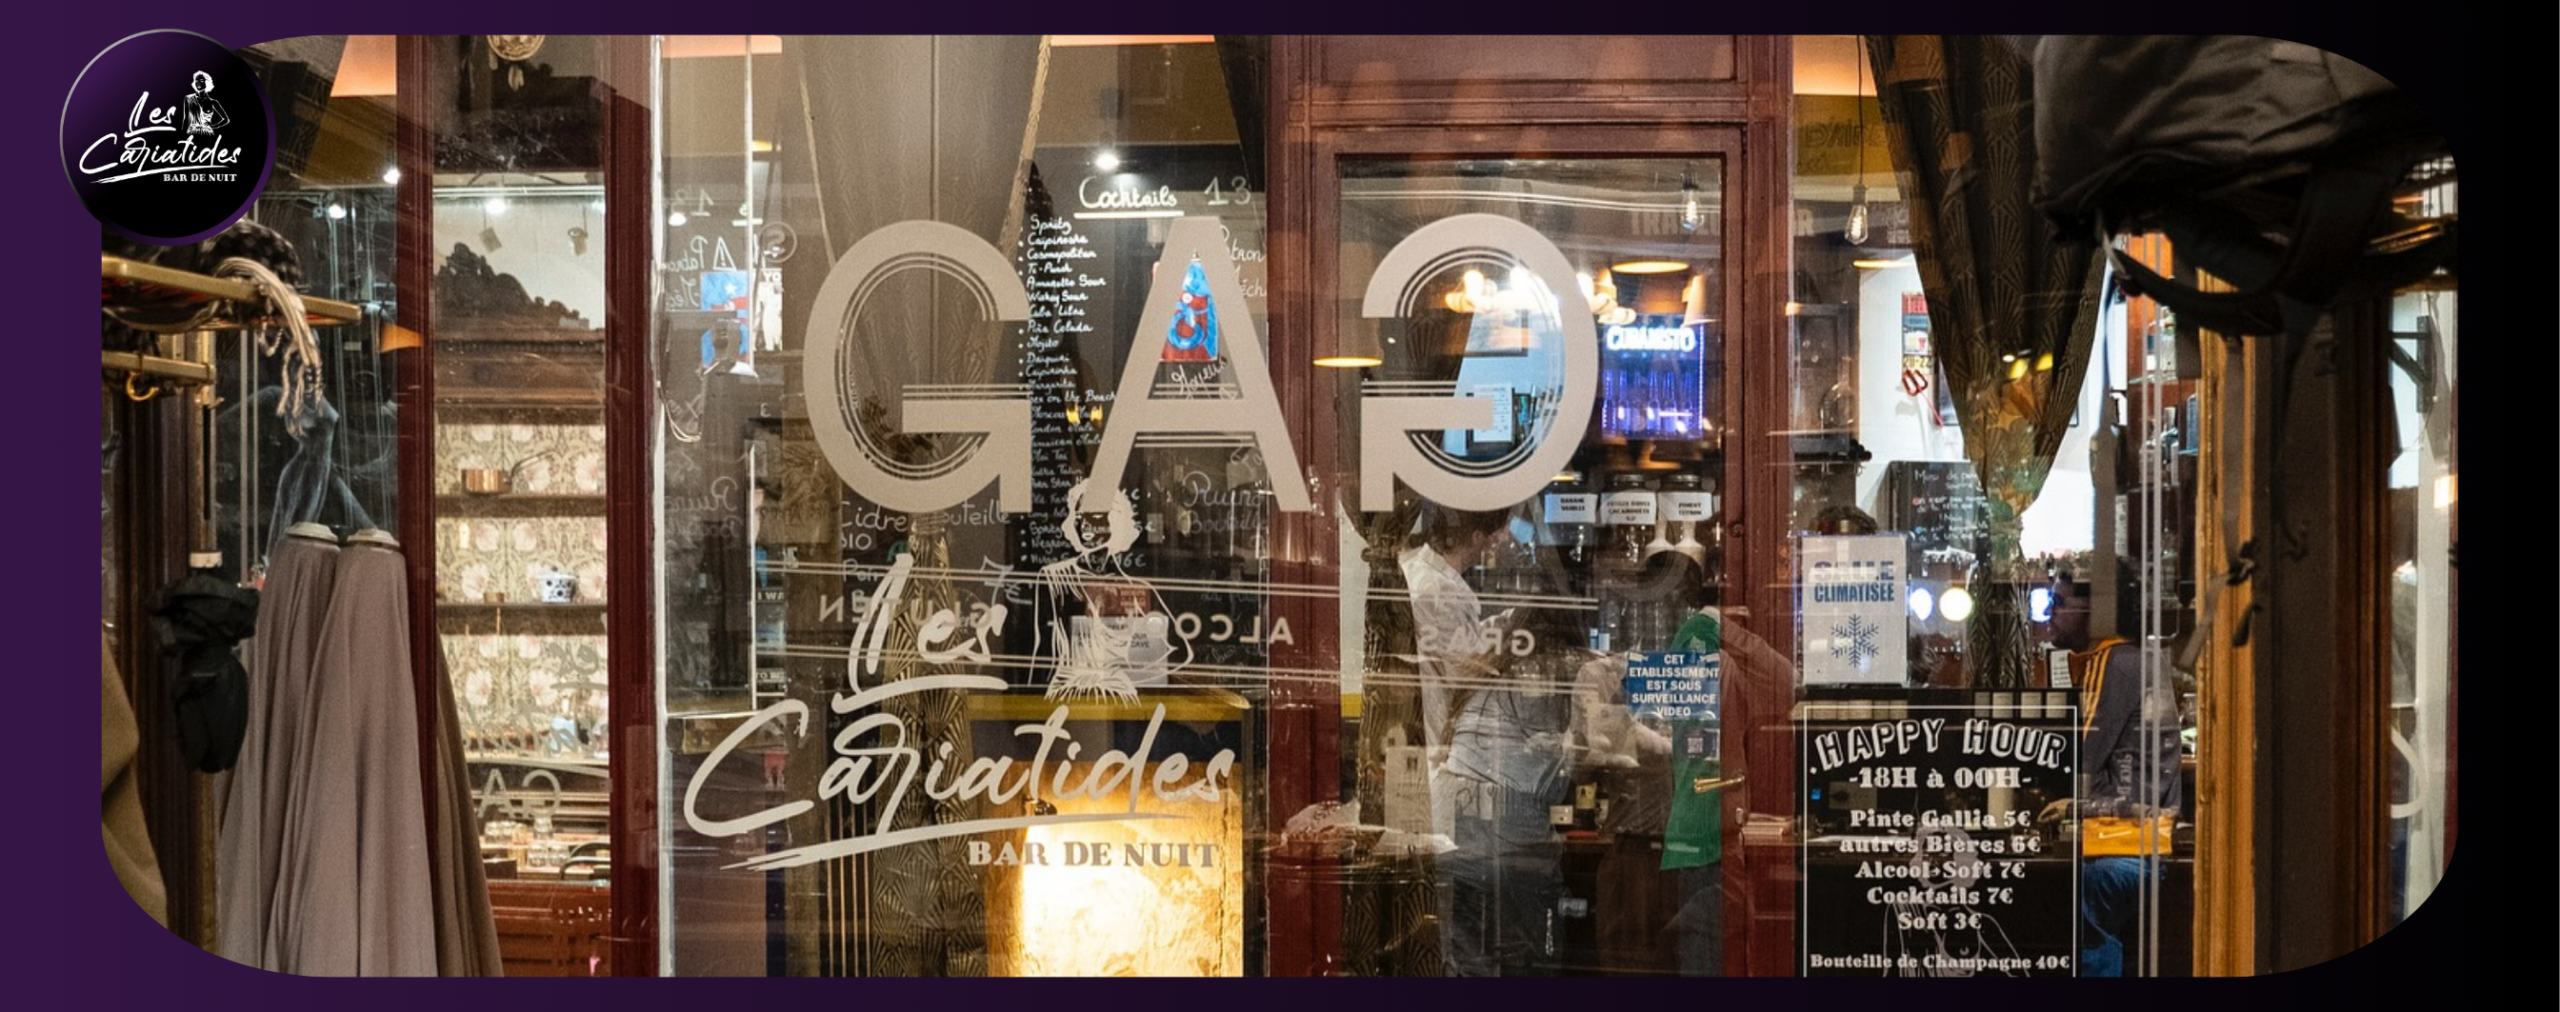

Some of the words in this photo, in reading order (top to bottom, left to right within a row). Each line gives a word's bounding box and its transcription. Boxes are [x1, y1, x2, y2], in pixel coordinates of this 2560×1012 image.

[1079, 176, 1178, 208] Cocktails
[1204, 176, 1250, 206] 13
[1814, 582, 1895, 602] CLIMATISEE
[831, 553, 1009, 714] Les
[1664, 654, 1685, 665] CET
[1629, 667, 1720, 678] ETABLISSEMENT
[1646, 680, 1668, 691] EST
[1670, 680, 1702, 691] SOUS
[1631, 693, 1717, 704] SURVEILLANCE
[1656, 706, 1692, 716] VIDEO
[1814, 718, 1945, 771] HAPPY
[1963, 718, 2068, 769] HOUR
[683, 698, 1237, 838] Cariatides
[1926, 768, 1945, 789] à
[1850, 809, 1915, 828] Pinte
[1920, 808, 1998, 829] Gallia
[2003, 810, 2031, 829] 5€
[1839, 836, 1919, 853] autres
[1926, 834, 2006, 853] Bières
[2011, 835, 2041, 853] 6€
[967, 840, 1050, 867] BAR
[1062, 841, 1112, 868] DE
[1124, 842, 1220, 869] NUIT
[1999, 861, 2026, 879] 7€
[1867, 886, 1980, 904] Cocktails
[1987, 886, 2013, 904] 7€
[1898, 912, 1948, 930] Soft
[1954, 912, 1982, 930] 3€
[1810, 953, 1892, 968] Bouteille
[1898, 953, 1919, 968] de
[1923, 953, 2032, 972] Champagne
[2035, 955, 2070, 970] 40€
